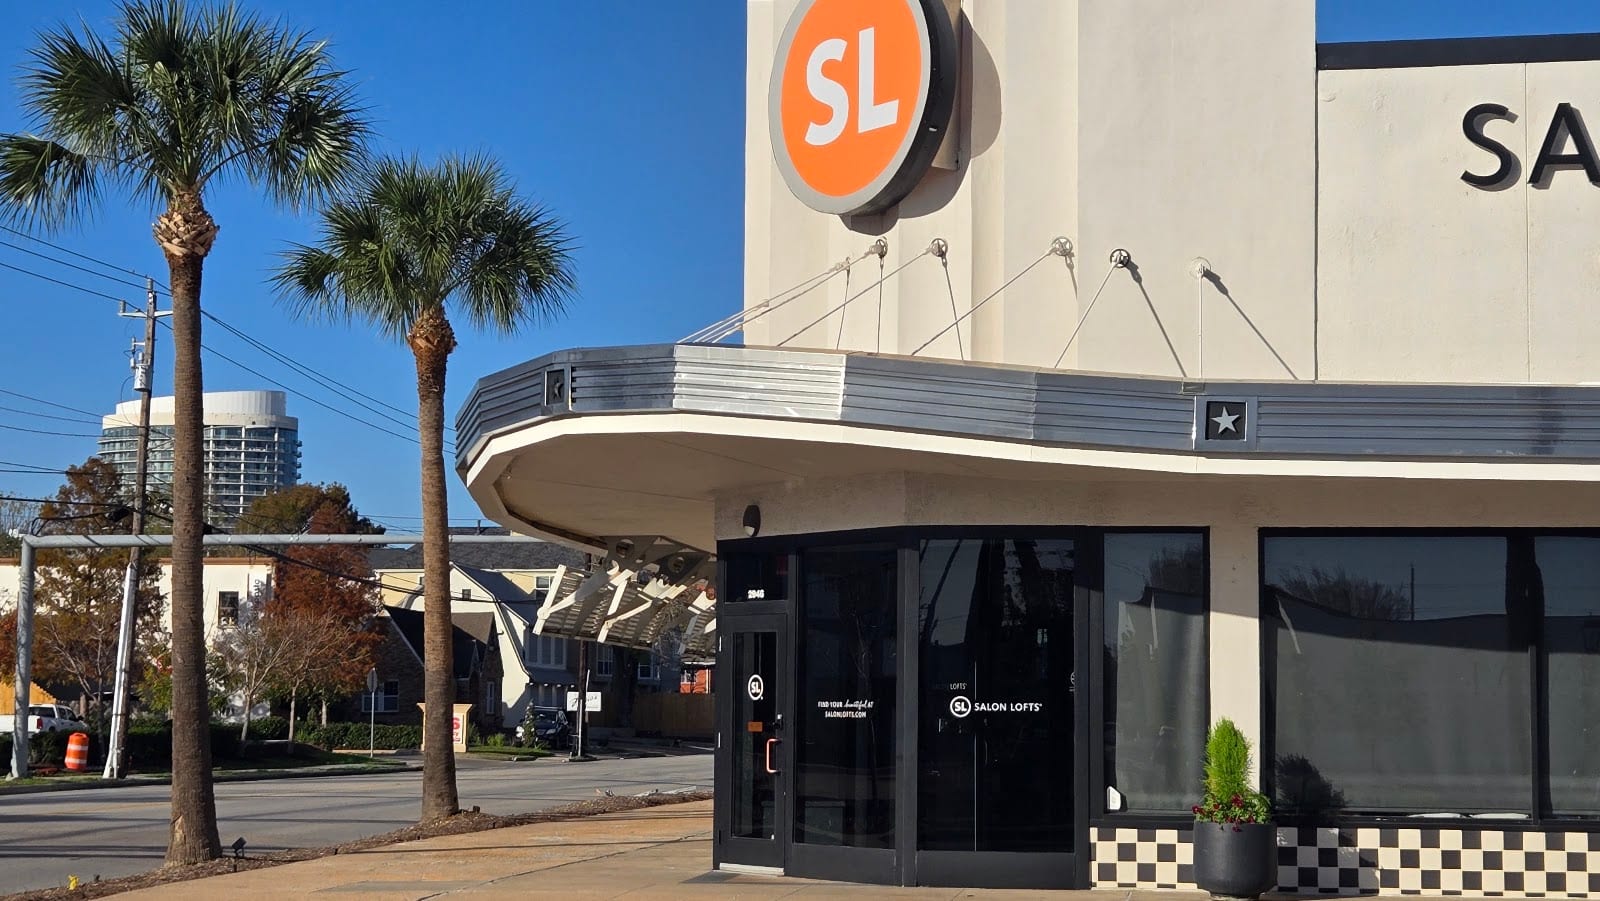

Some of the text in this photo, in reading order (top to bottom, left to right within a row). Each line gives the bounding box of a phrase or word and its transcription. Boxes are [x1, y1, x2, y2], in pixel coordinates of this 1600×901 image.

[804, 26, 900, 146] SL
[1460, 102, 1600, 184] SA
[954, 701, 1040, 712] SL SALON LOFTS
